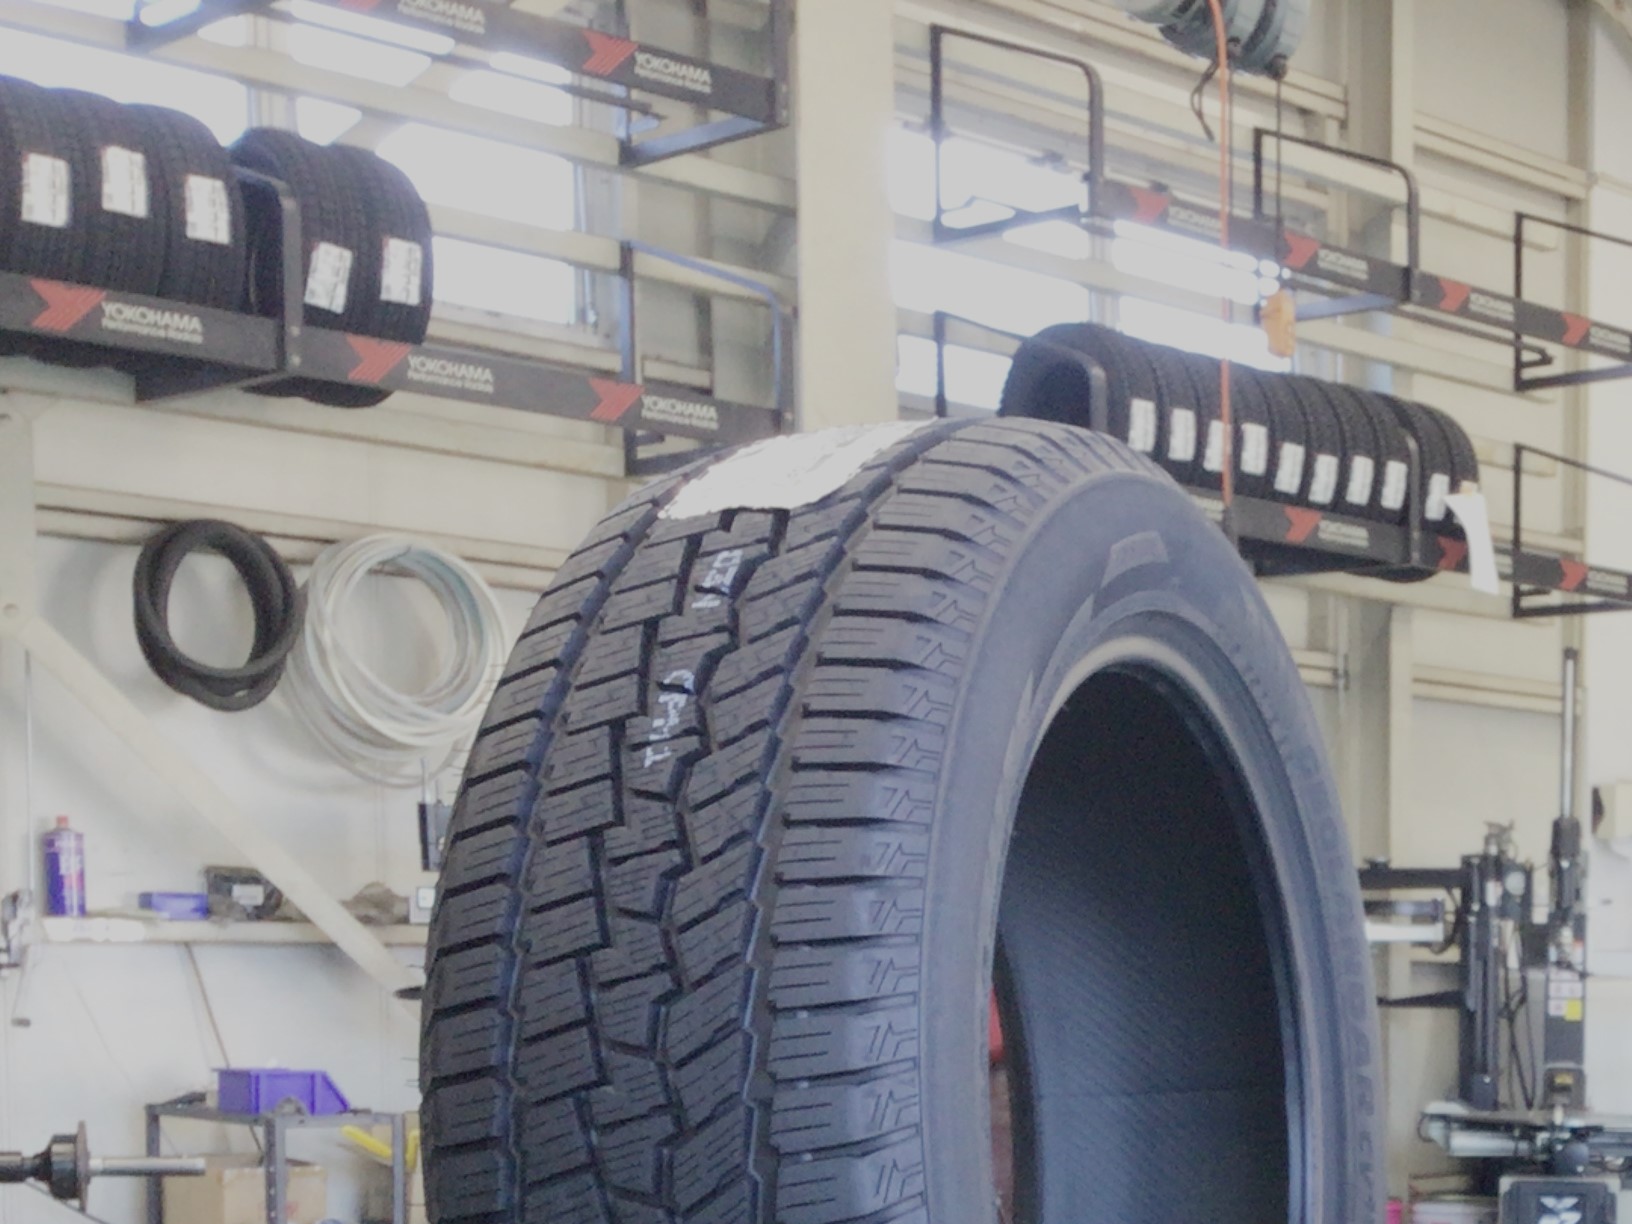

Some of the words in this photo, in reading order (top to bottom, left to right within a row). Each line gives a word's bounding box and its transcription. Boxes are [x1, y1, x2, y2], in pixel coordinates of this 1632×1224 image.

[397, 0, 485, 24] OKOHAMA
[101, 301, 203, 334] YOKOHAMA
[408, 354, 494, 384] YOKOHAMA
[641, 394, 718, 421] YOKOHAMA
